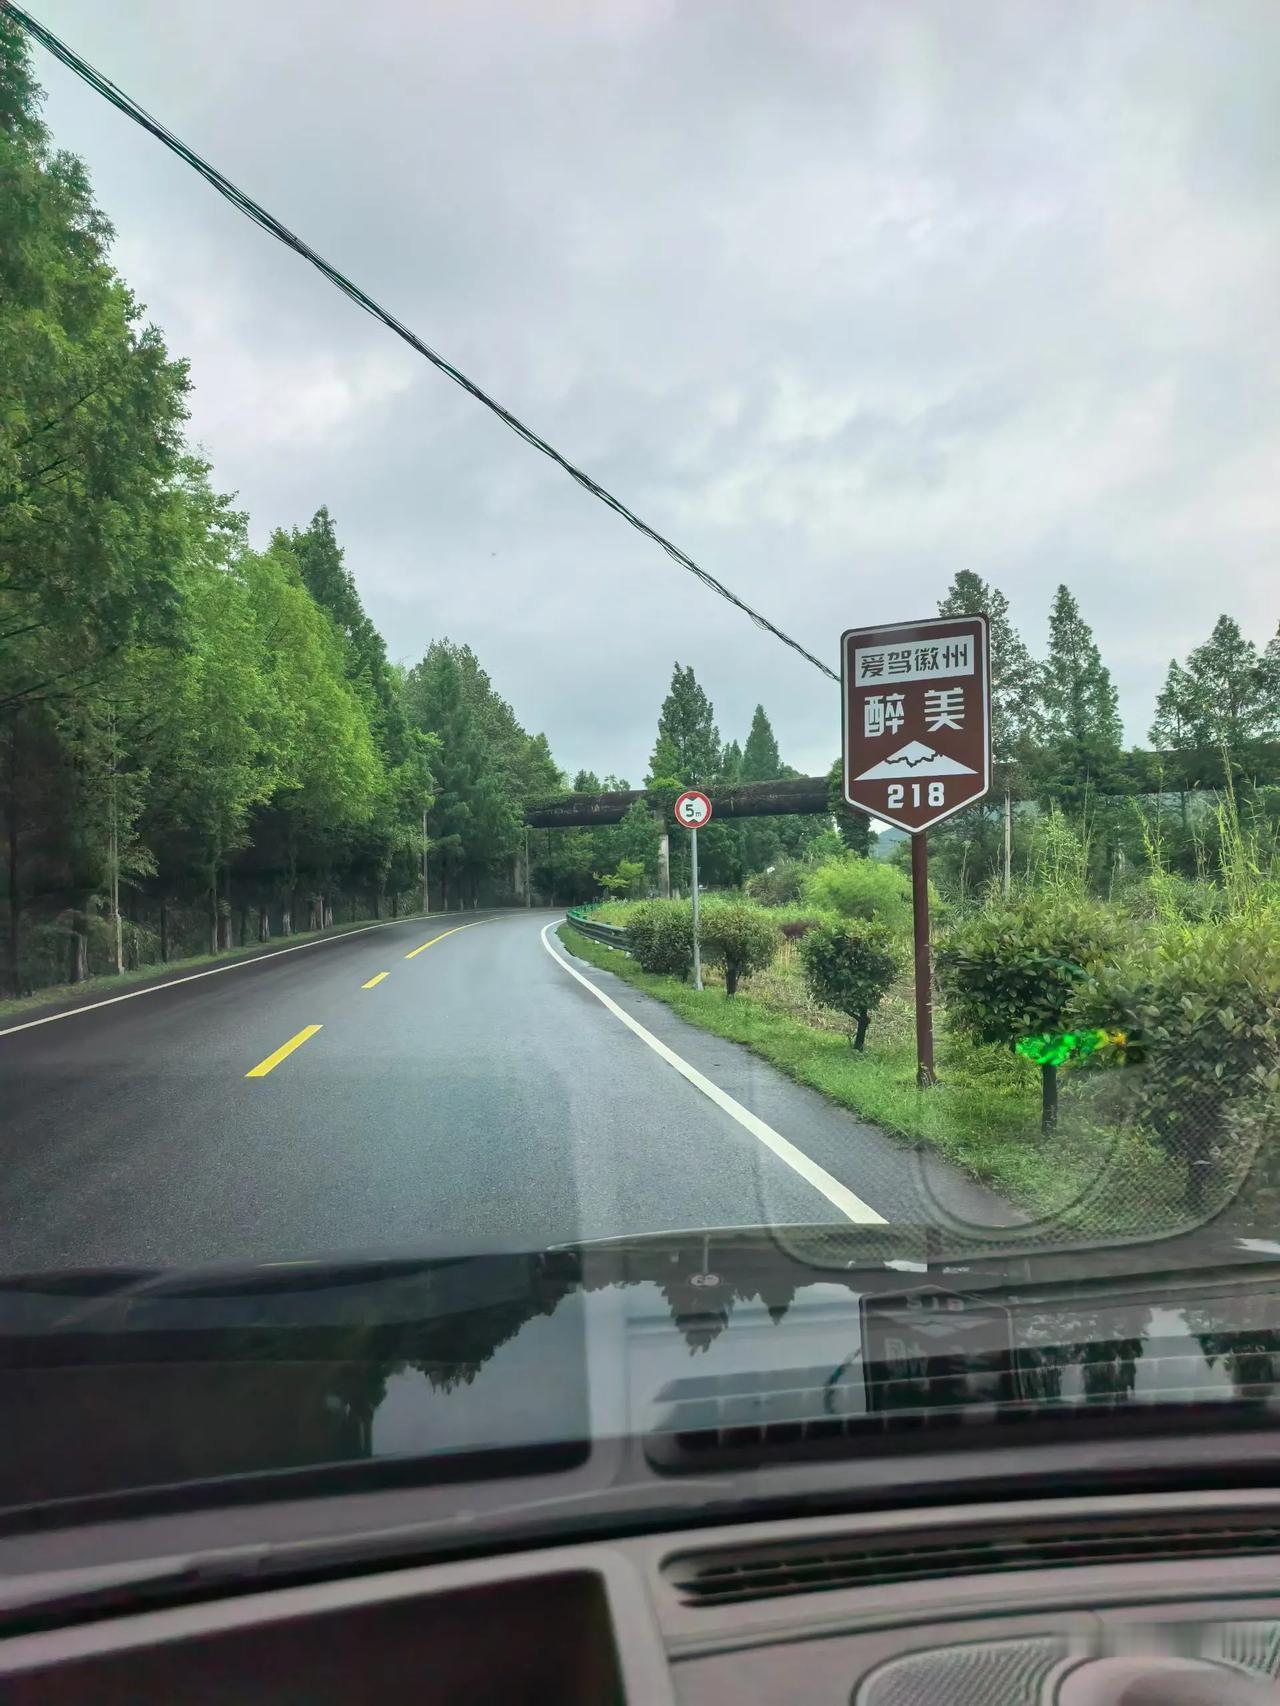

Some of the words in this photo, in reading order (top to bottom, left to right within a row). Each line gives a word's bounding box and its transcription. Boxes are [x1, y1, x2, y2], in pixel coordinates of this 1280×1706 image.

[861, 643, 968, 678] 爱驾徽州
[864, 687, 965, 737] 醉美
[887, 782, 945, 809] 218
